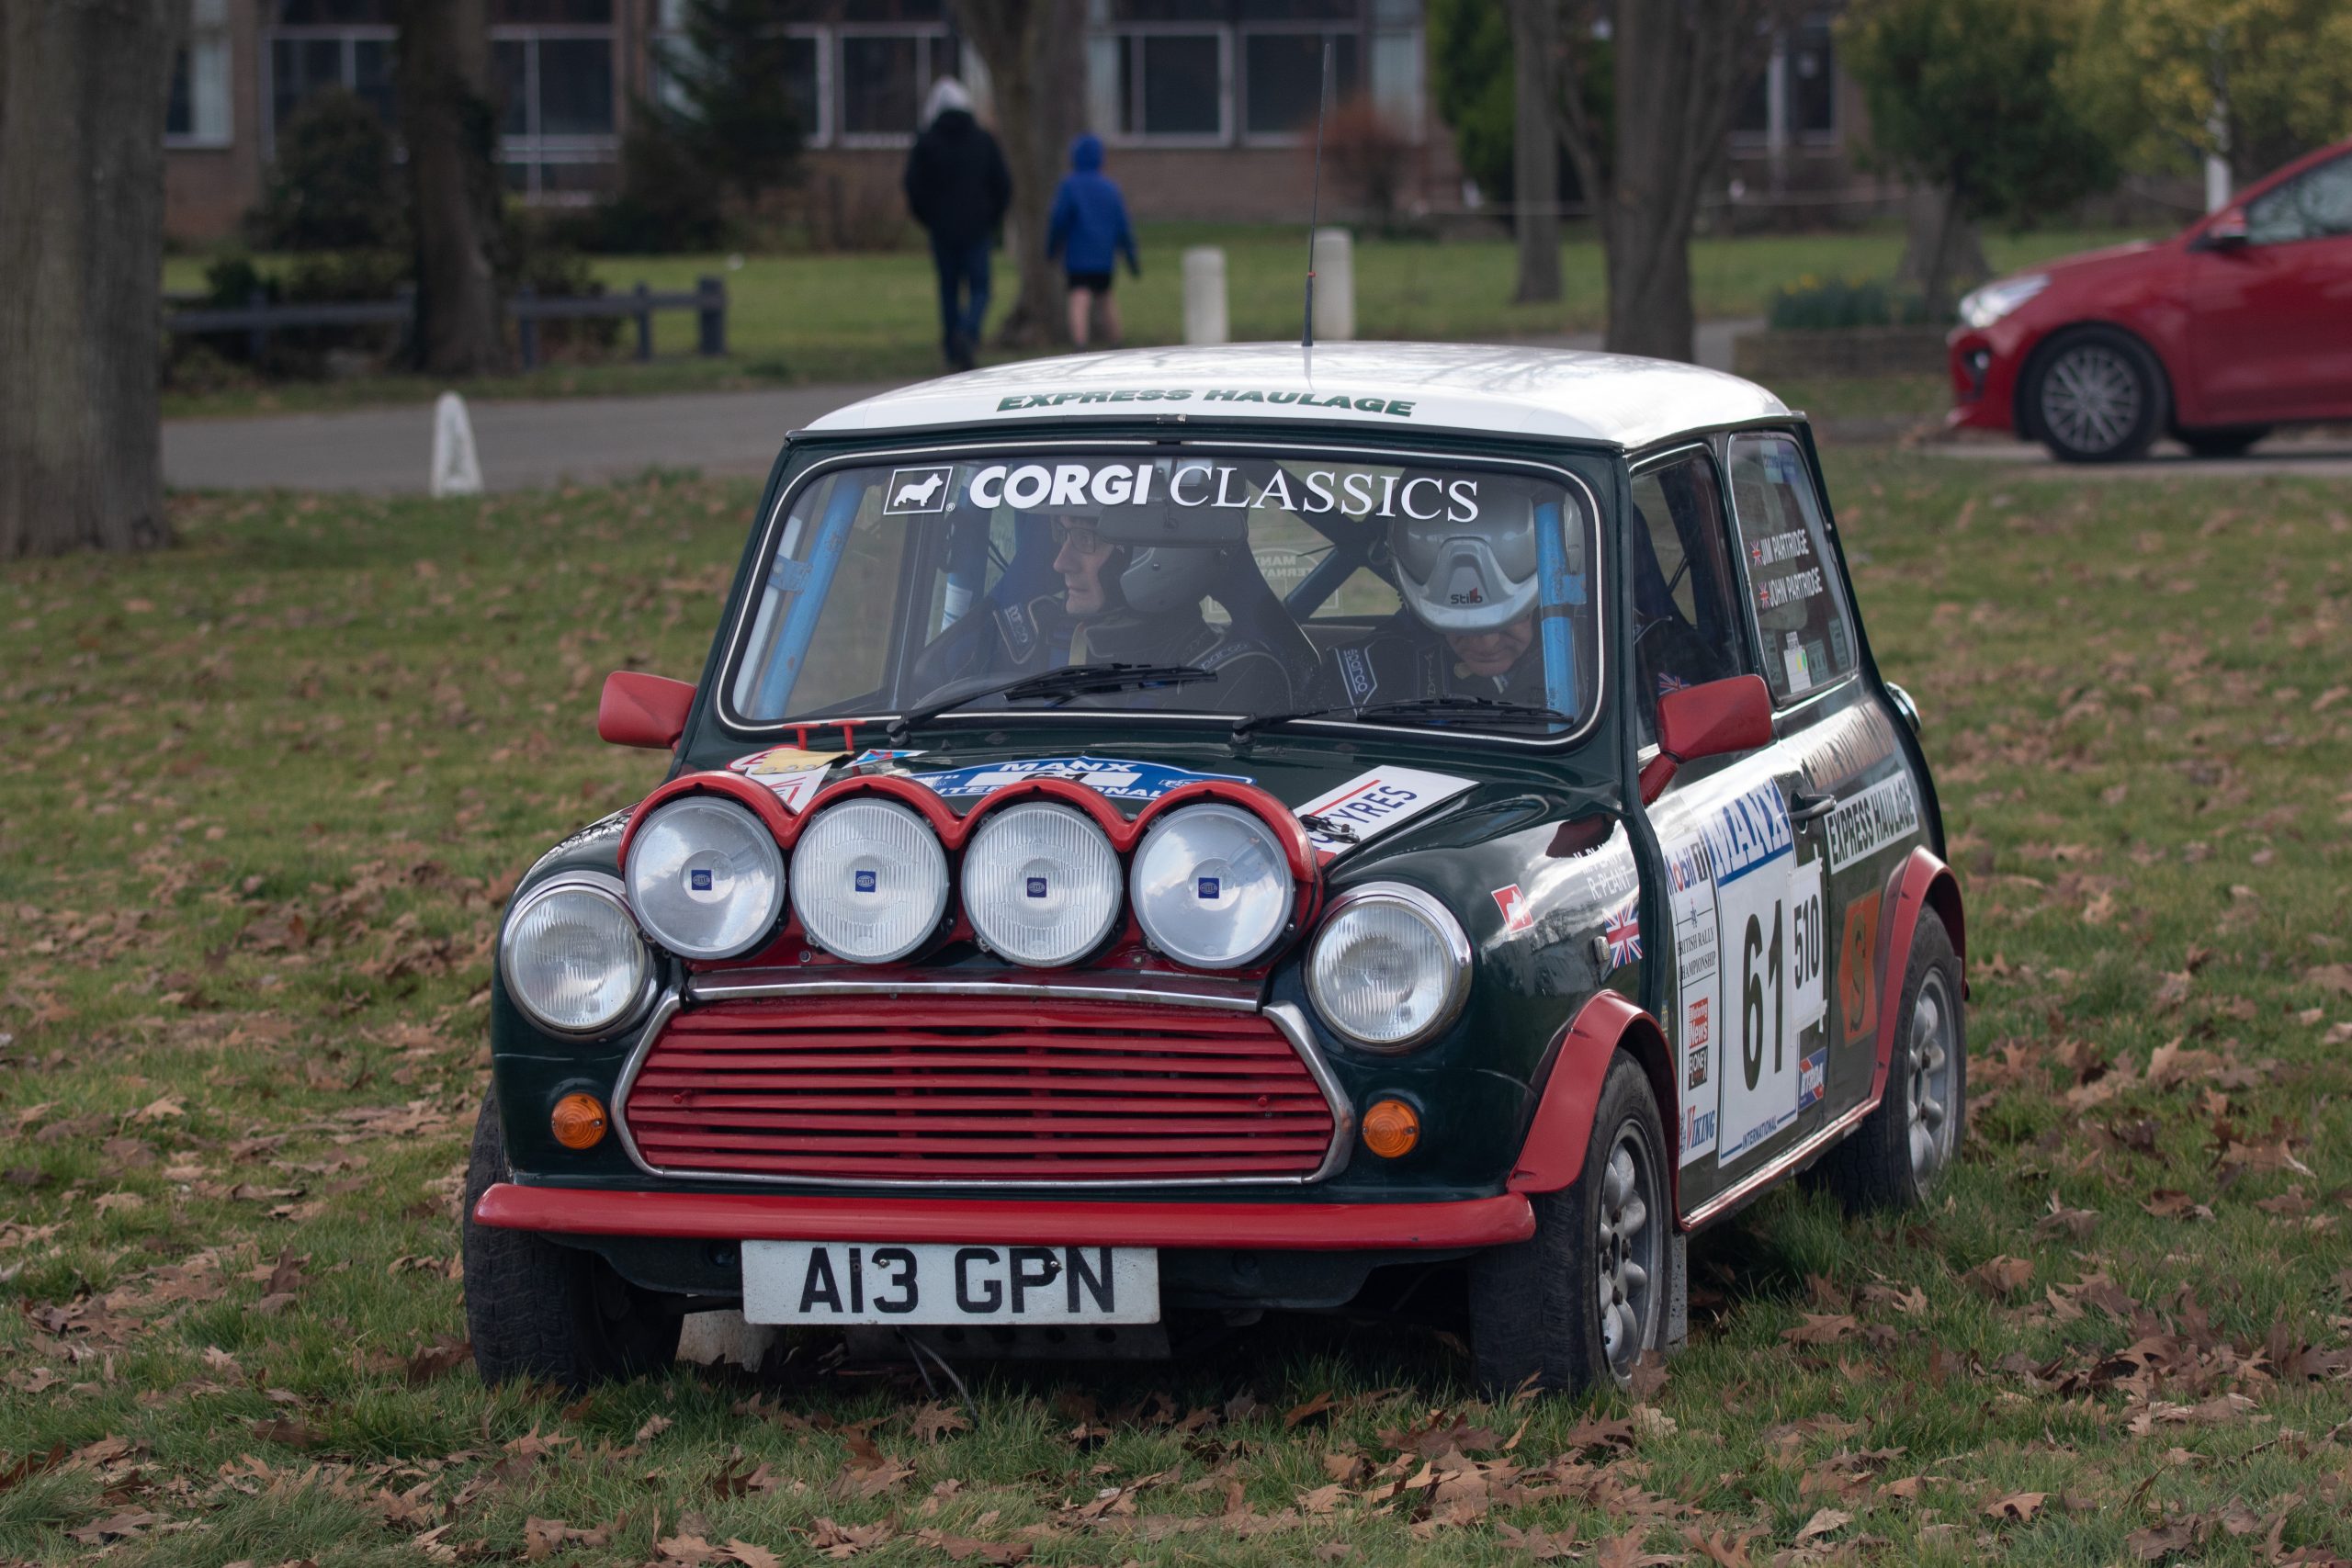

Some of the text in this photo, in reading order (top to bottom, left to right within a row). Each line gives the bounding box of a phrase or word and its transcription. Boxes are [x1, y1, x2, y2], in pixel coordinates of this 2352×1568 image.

[996, 389, 1417, 418] EXPRESS HAULAGE
[969, 465, 1479, 523] CORGI CLASSICS
[1771, 528, 1809, 561] PARTRIDGE
[1768, 567, 1823, 607] JOHN PARTRIDGE
[999, 761, 1137, 773] MANX
[1703, 778, 1792, 879] MANX
[1827, 779, 1915, 865] EXPRESS HAULAGE
[1665, 847, 1697, 896] Mobil
[1677, 926, 1714, 956] BRITISH RALLY
[1794, 894, 1820, 989] 510
[1679, 951, 1716, 980] CHAMPIONSHIP
[1743, 898, 1783, 1091] 61
[1690, 1021, 1708, 1046] News
[1687, 1105, 1715, 1151] VIKING
[1742, 1116, 1777, 1149] INTERNATIONAL
[798, 1247, 1115, 1314] A13 GPN
